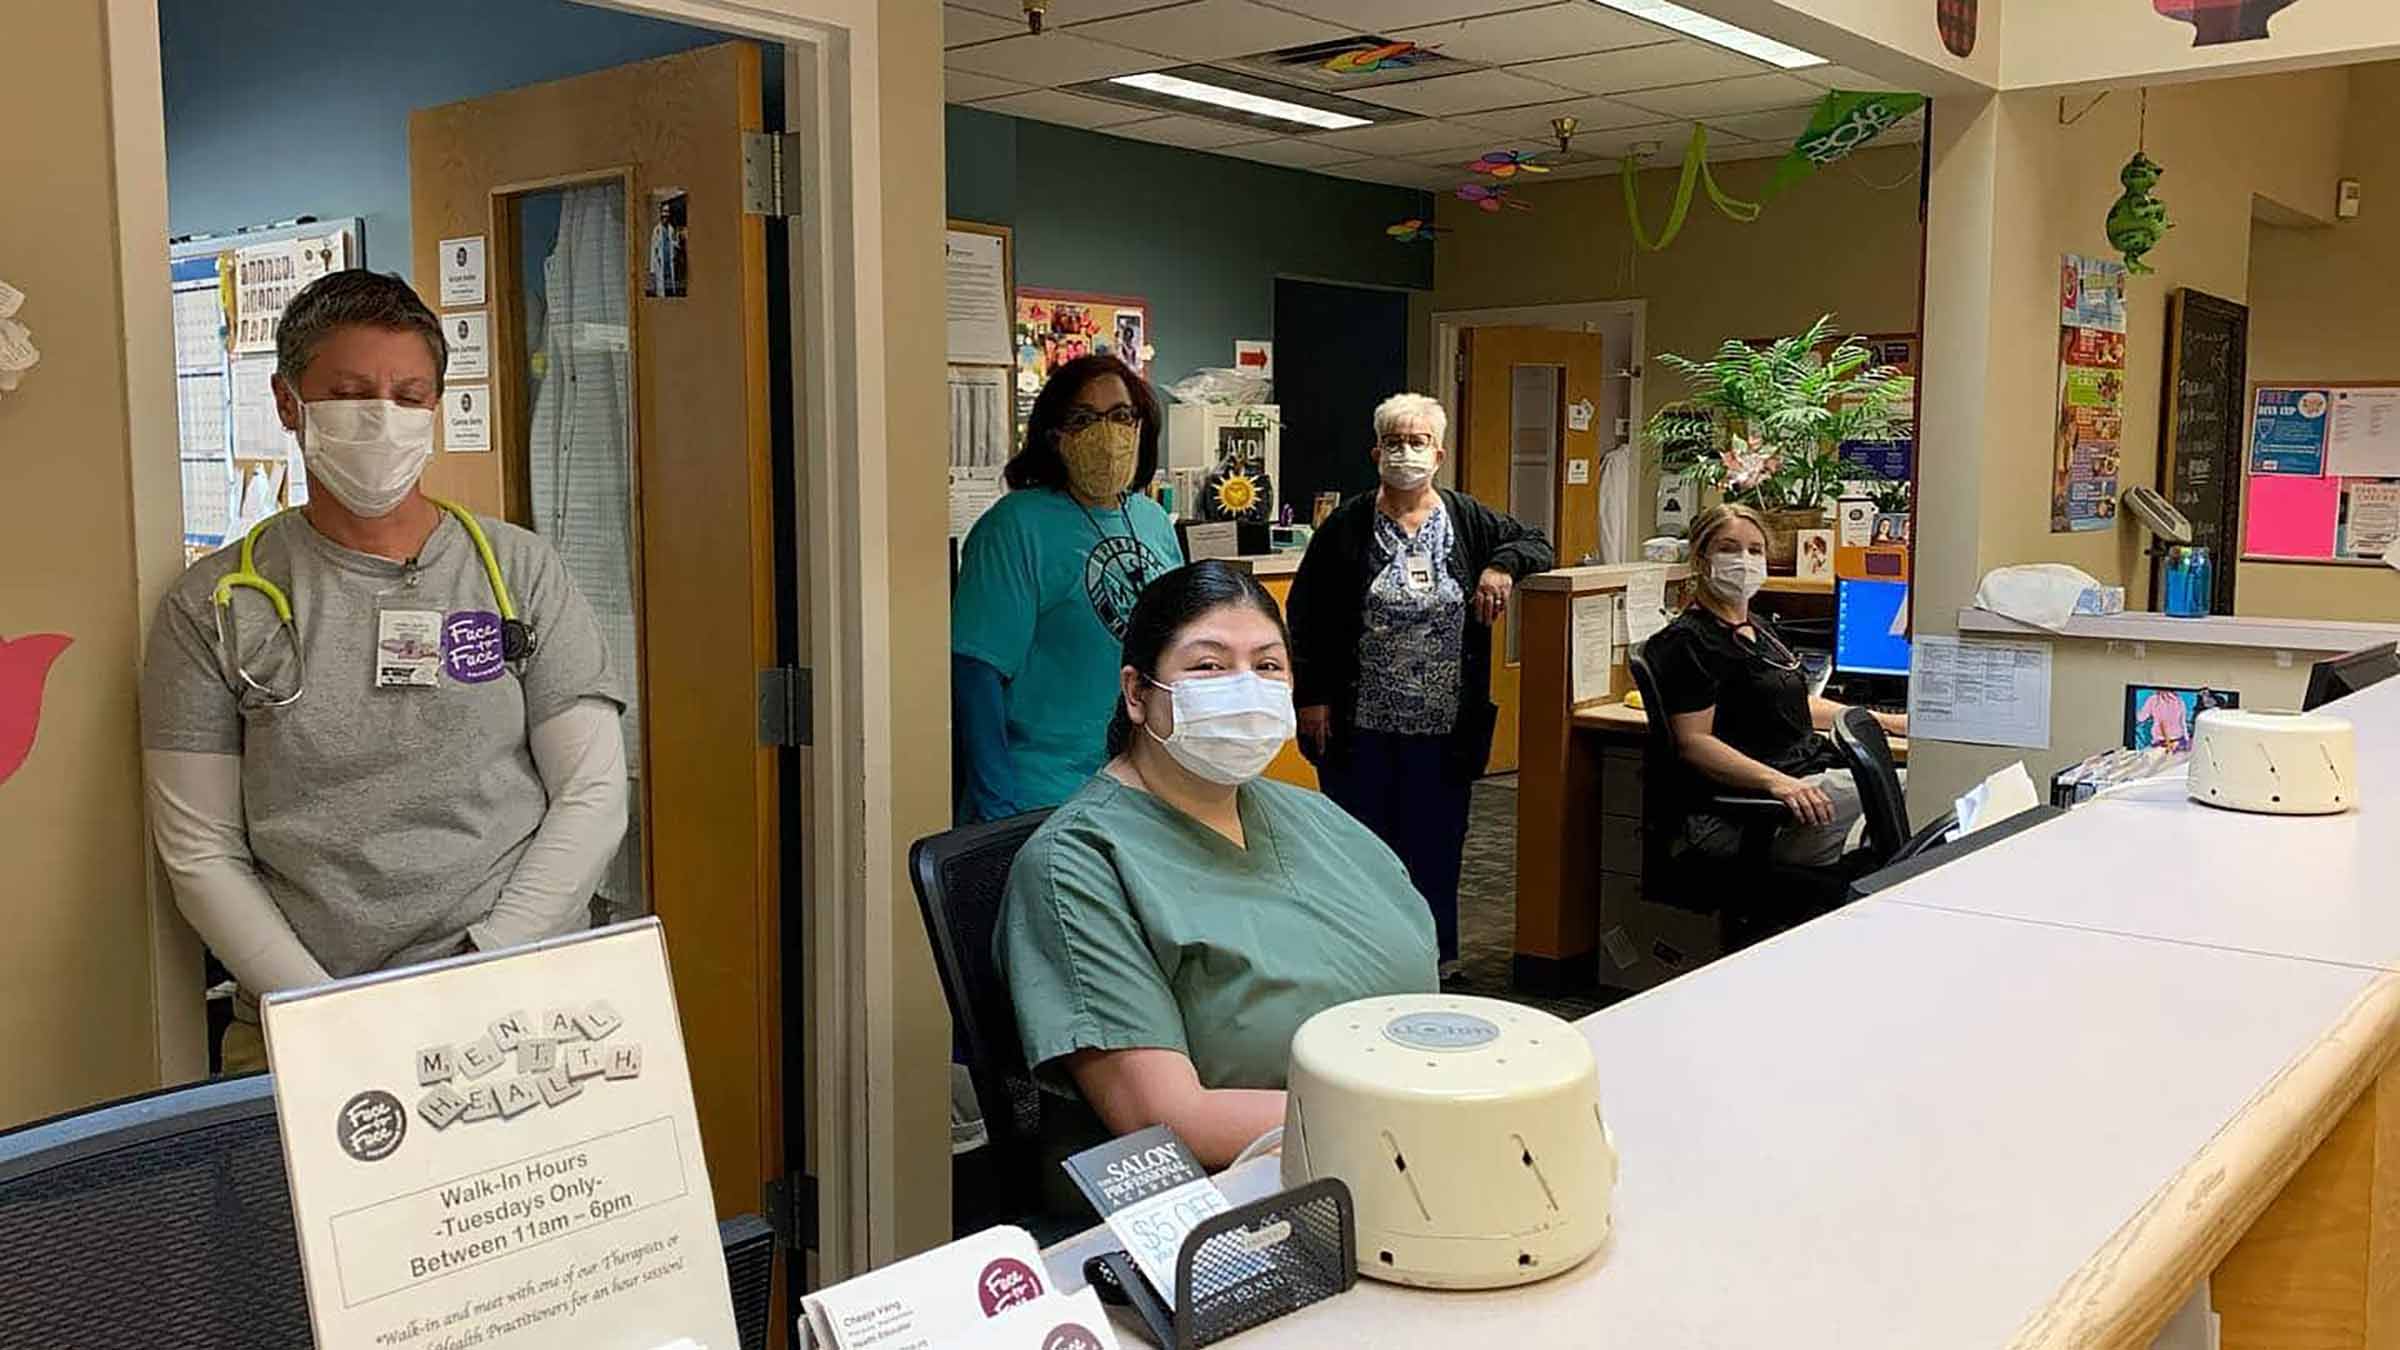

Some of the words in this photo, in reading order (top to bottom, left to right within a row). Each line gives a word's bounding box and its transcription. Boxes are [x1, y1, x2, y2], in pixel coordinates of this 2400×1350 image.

[448, 619, 499, 643] Face
[449, 644, 499, 670] Face
[440, 1172, 521, 1209] Walk-In
[526, 1151, 588, 1184] Hours
[1107, 1144, 1180, 1181] SALON
[410, 1234, 508, 1278] Between
[512, 1213, 570, 1244] 11am
[589, 1192, 634, 1220] 6pm
[434, 1191, 546, 1237] -Tuesdays
[549, 1177, 603, 1204] Only-
[443, 1300, 472, 1326] and
[474, 1295, 503, 1315] meet
[506, 1281, 537, 1306] with
[538, 1278, 561, 1295] one
[561, 1265, 579, 1292] of
[577, 1263, 600, 1279] our
[600, 1239, 666, 1272] Therapists
[666, 1233, 682, 1250] or
[486, 1300, 570, 1339] Practitioners
[569, 1289, 591, 1317] for
[591, 1285, 609, 1302] an
[610, 1272, 639, 1294] hour
